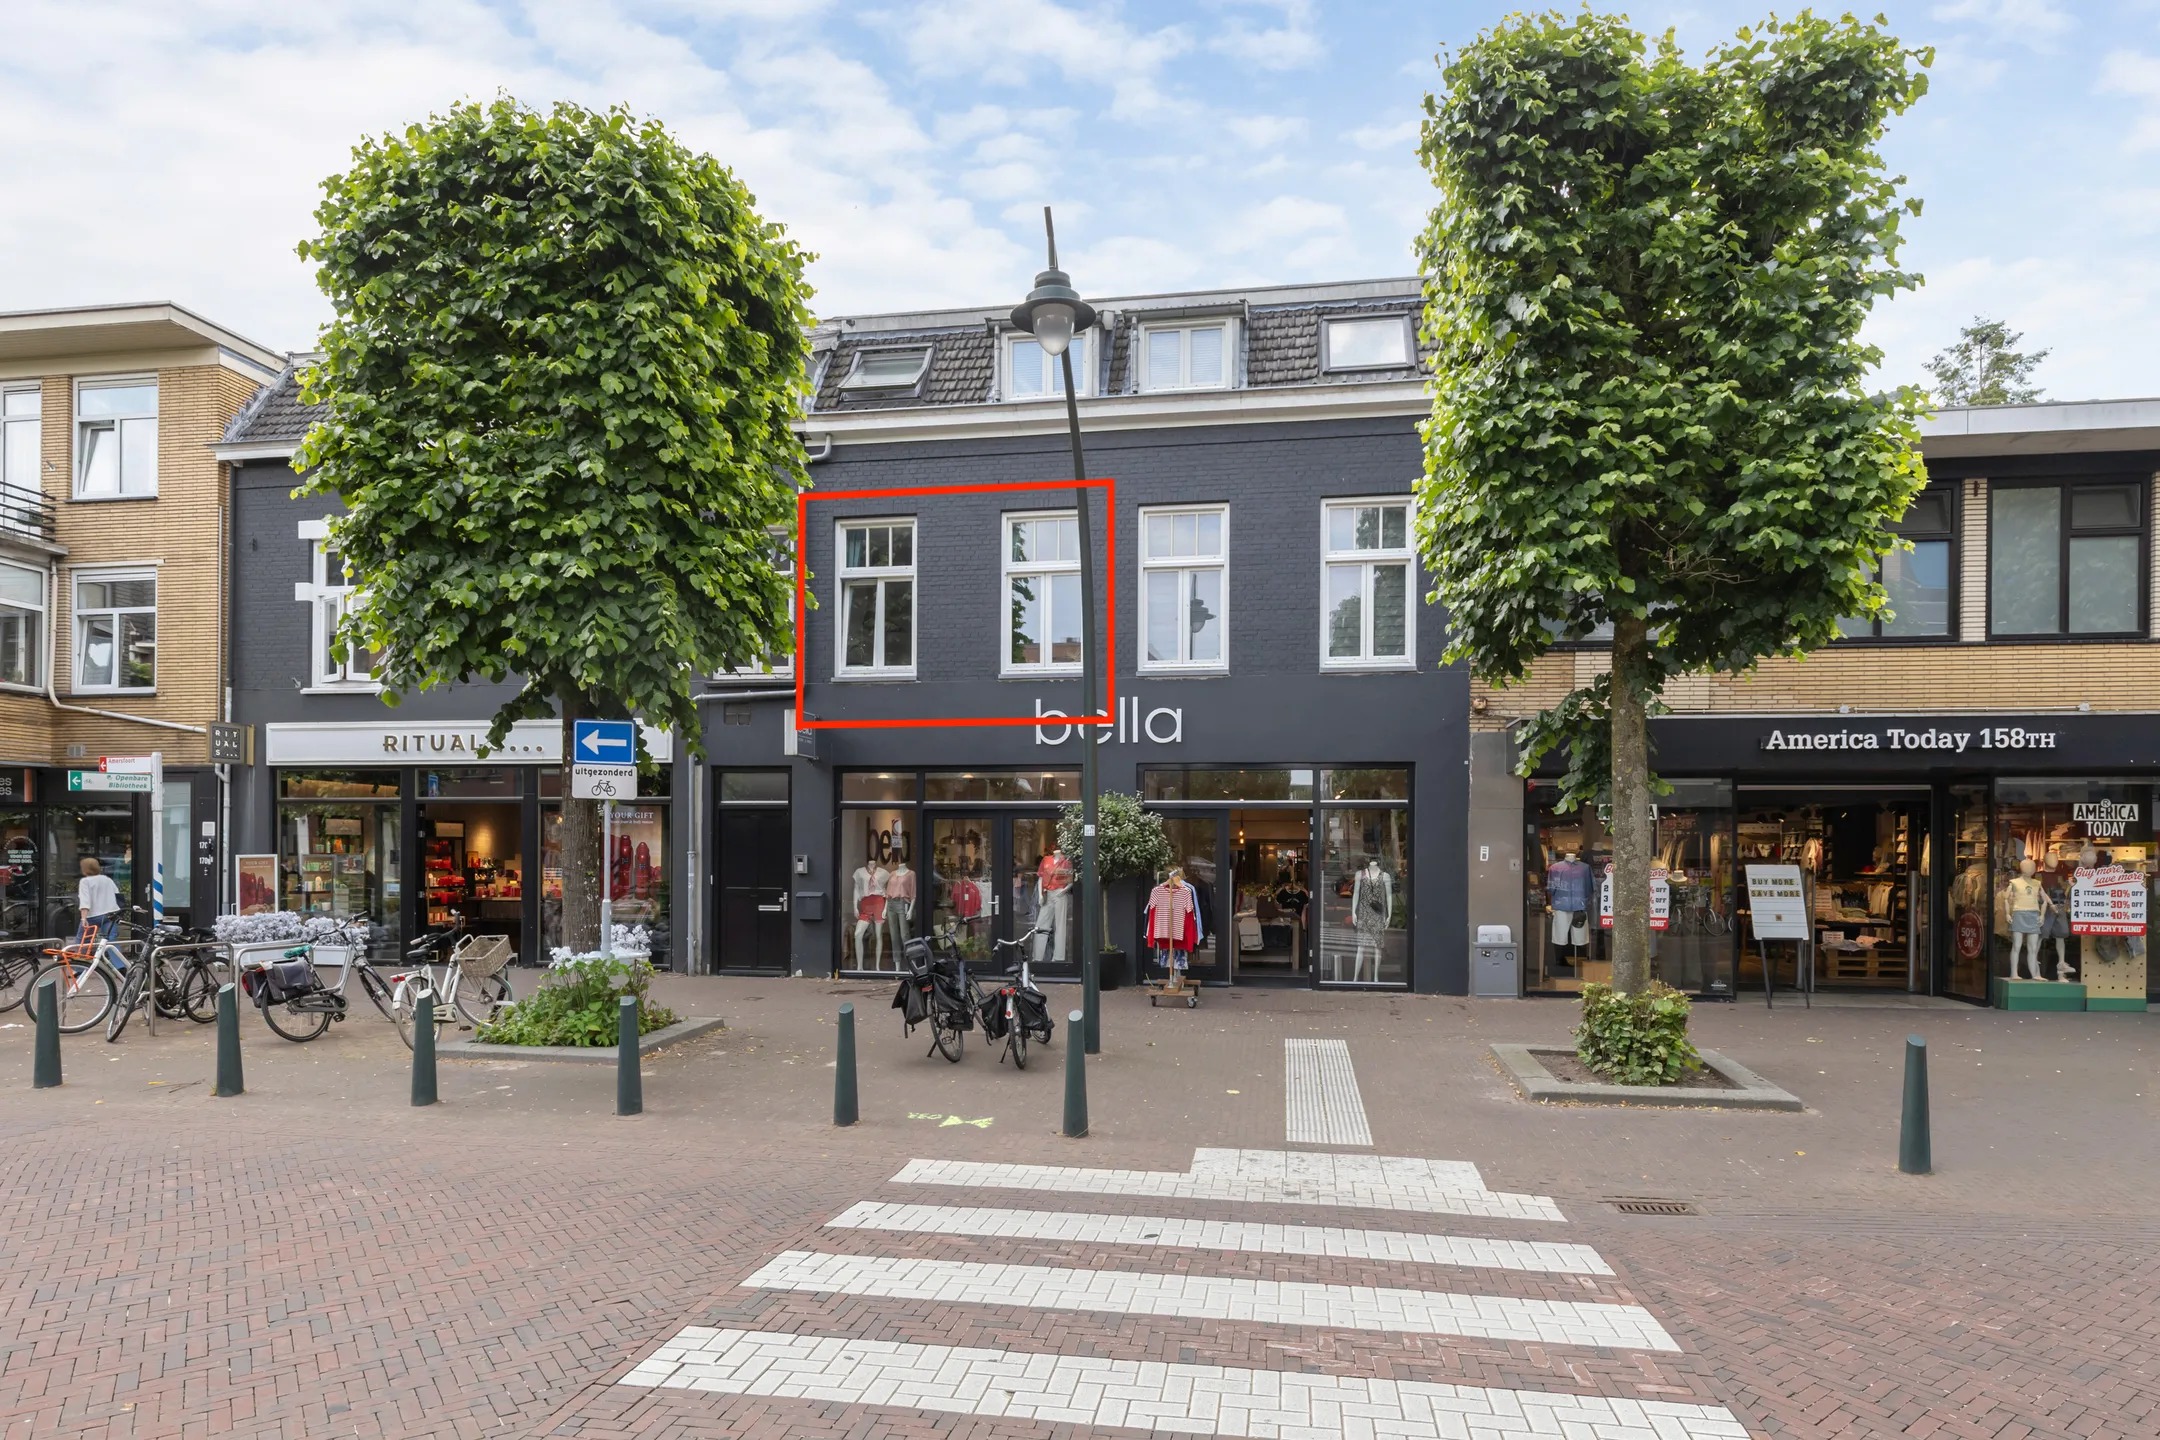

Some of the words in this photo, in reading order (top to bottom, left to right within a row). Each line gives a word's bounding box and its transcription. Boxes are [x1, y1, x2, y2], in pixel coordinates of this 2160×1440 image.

[1766, 729, 1879, 750] America
[1887, 728, 1971, 753] Today
[1979, 727, 2056, 749] 158TH
[575, 767, 633, 778] uitgezonderd
[115, 774, 148, 782] Openbare
[634, 811, 654, 819] GIFT
[2075, 804, 2137, 820] AMERICA
[2086, 821, 2126, 837] TODAY
[2075, 867, 2095, 879] Buy
[1752, 878, 1769, 886] BUY
[2094, 875, 2116, 885] save
[2118, 872, 2143, 881] more
[1603, 884, 1609, 892] 2
[2074, 889, 2080, 897] 2
[2110, 889, 2130, 898] 20%
[2074, 900, 2080, 908] 3
[2110, 900, 2130, 909] 30%
[2110, 911, 2130, 920] 40%
[1961, 927, 1977, 938] 50%
[2073, 924, 2089, 932] OFF
[1963, 937, 1974, 947] off
